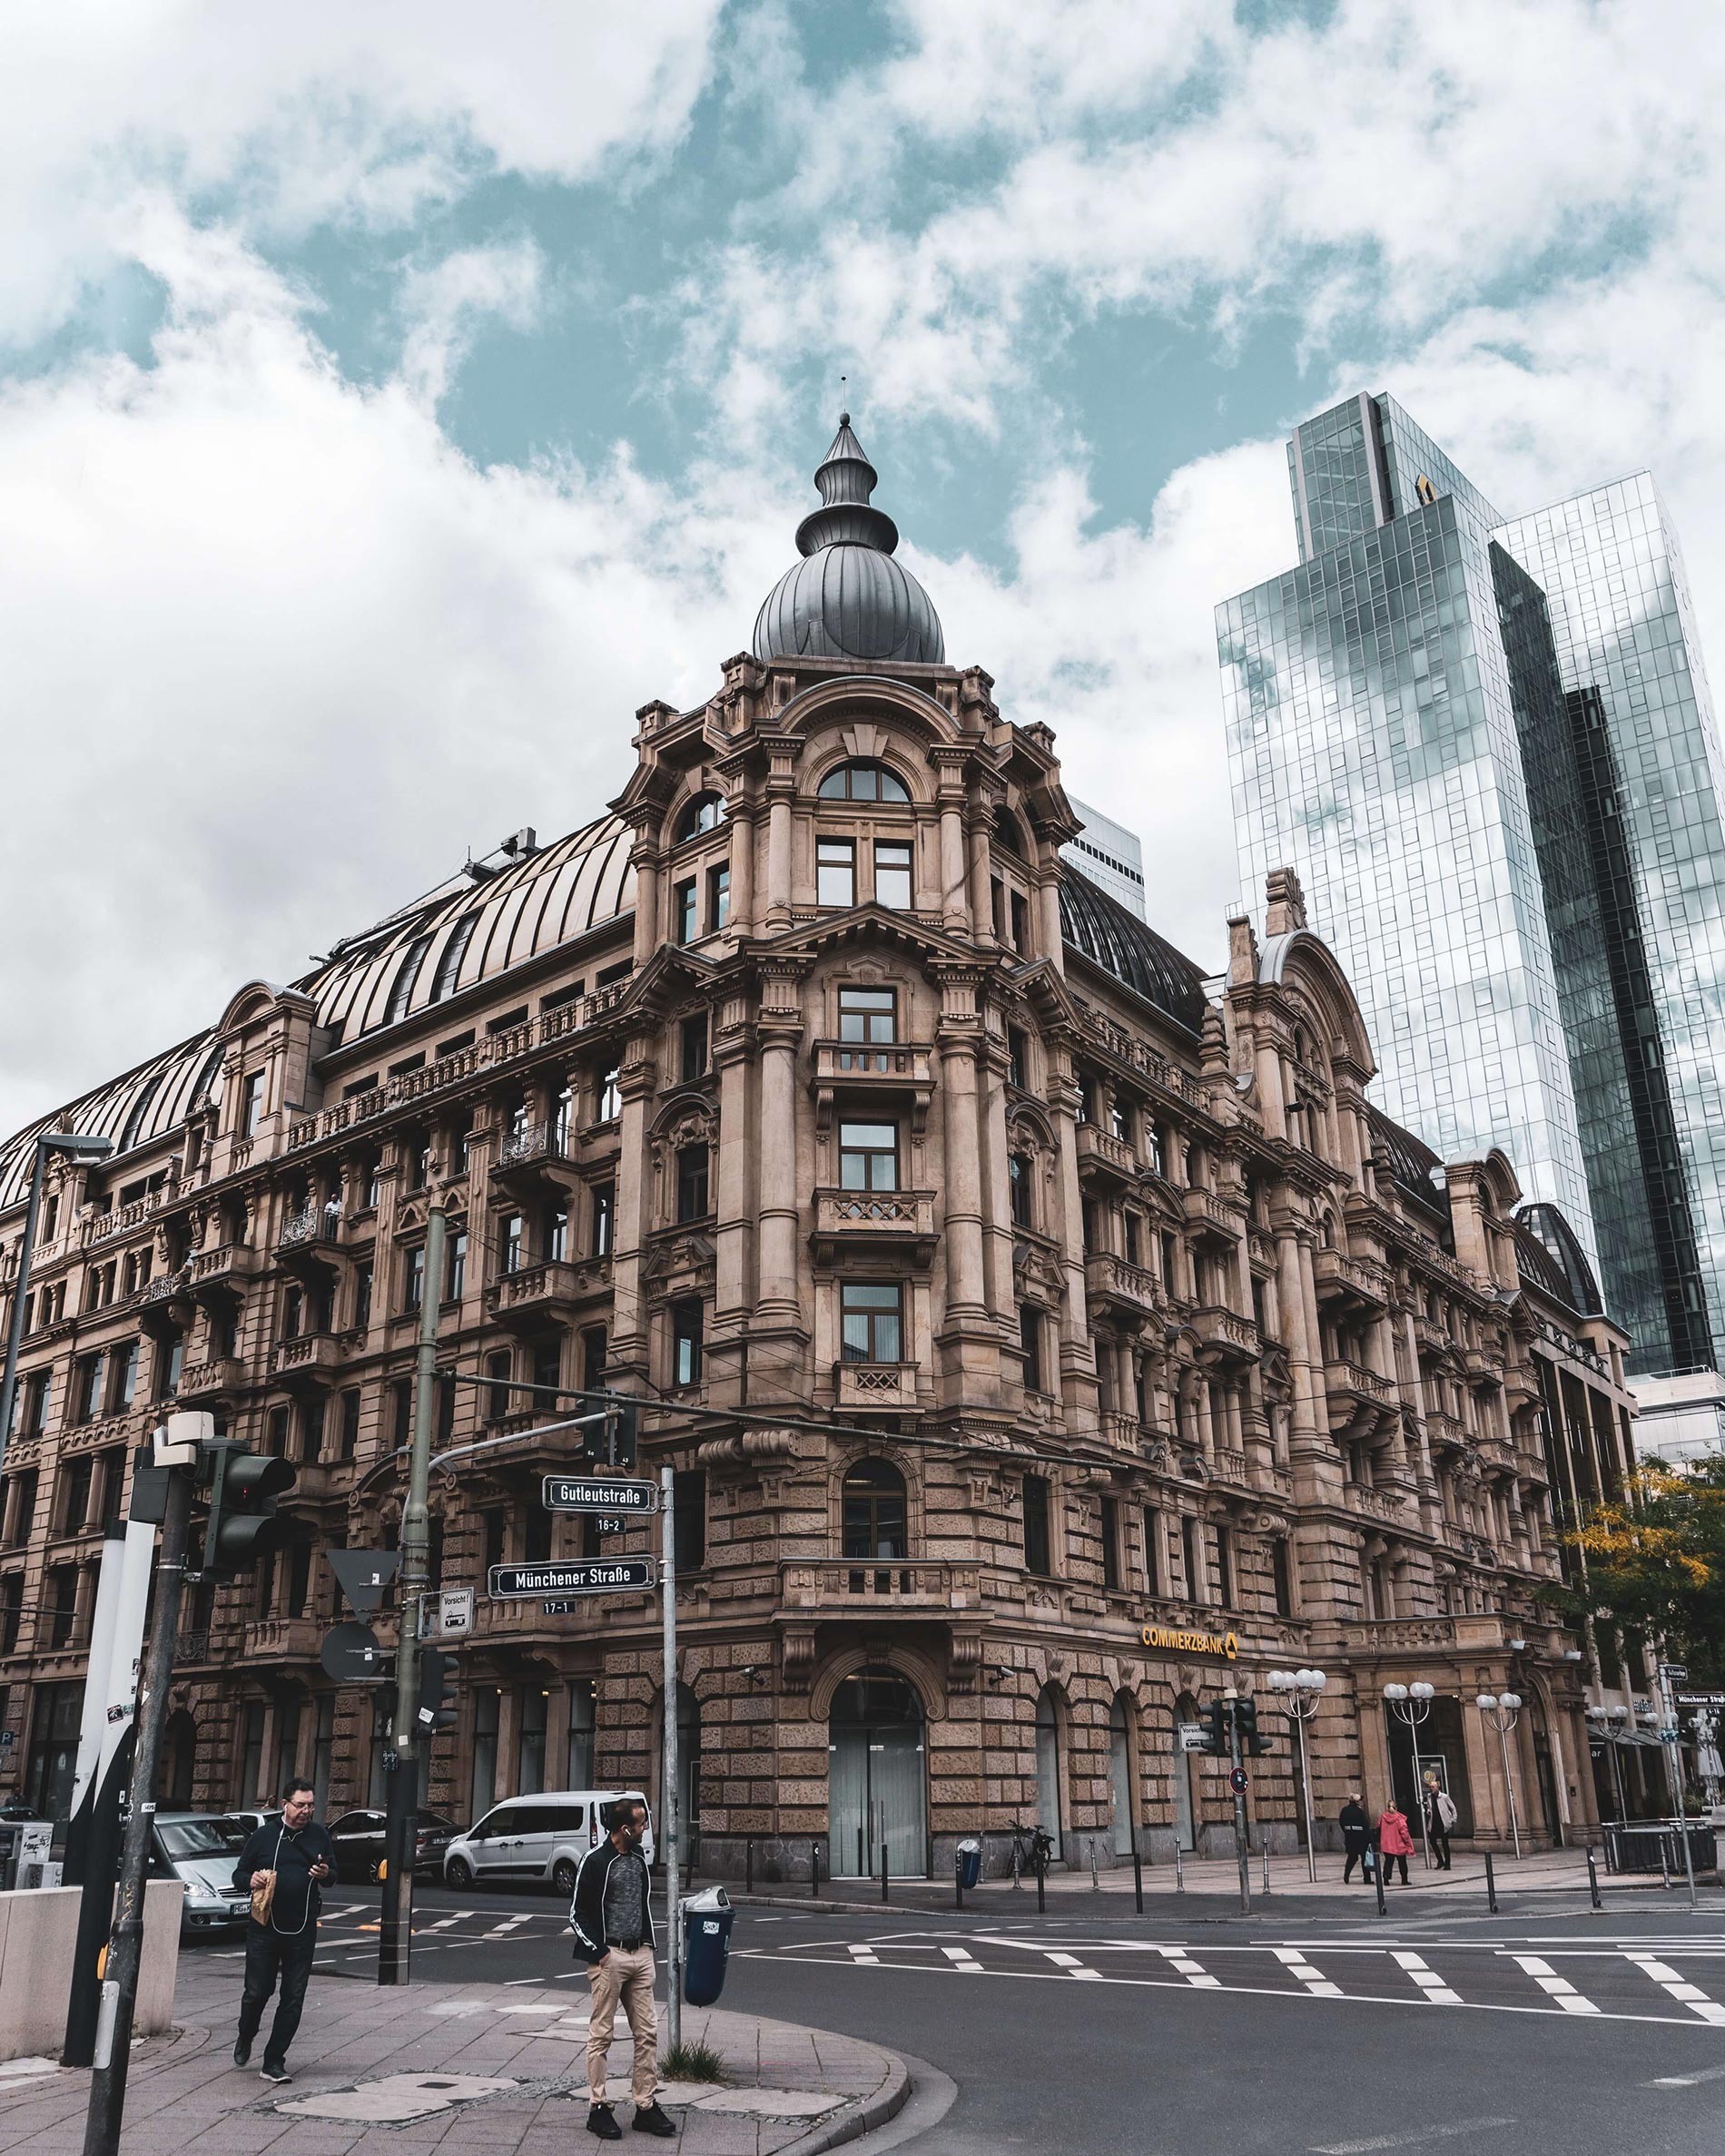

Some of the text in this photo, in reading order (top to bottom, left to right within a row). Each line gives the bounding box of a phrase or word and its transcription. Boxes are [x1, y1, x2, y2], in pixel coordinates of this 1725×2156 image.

[560, 1485, 640, 1504] Gutleutstraße
[598, 1520, 619, 1531] 16-2
[516, 1567, 631, 1589] Münchener Straße
[545, 1602, 568, 1614] 17-1
[1142, 1626, 1225, 1655] COMMERZBANK
[1710, 1696, 1725, 1704] Straß
